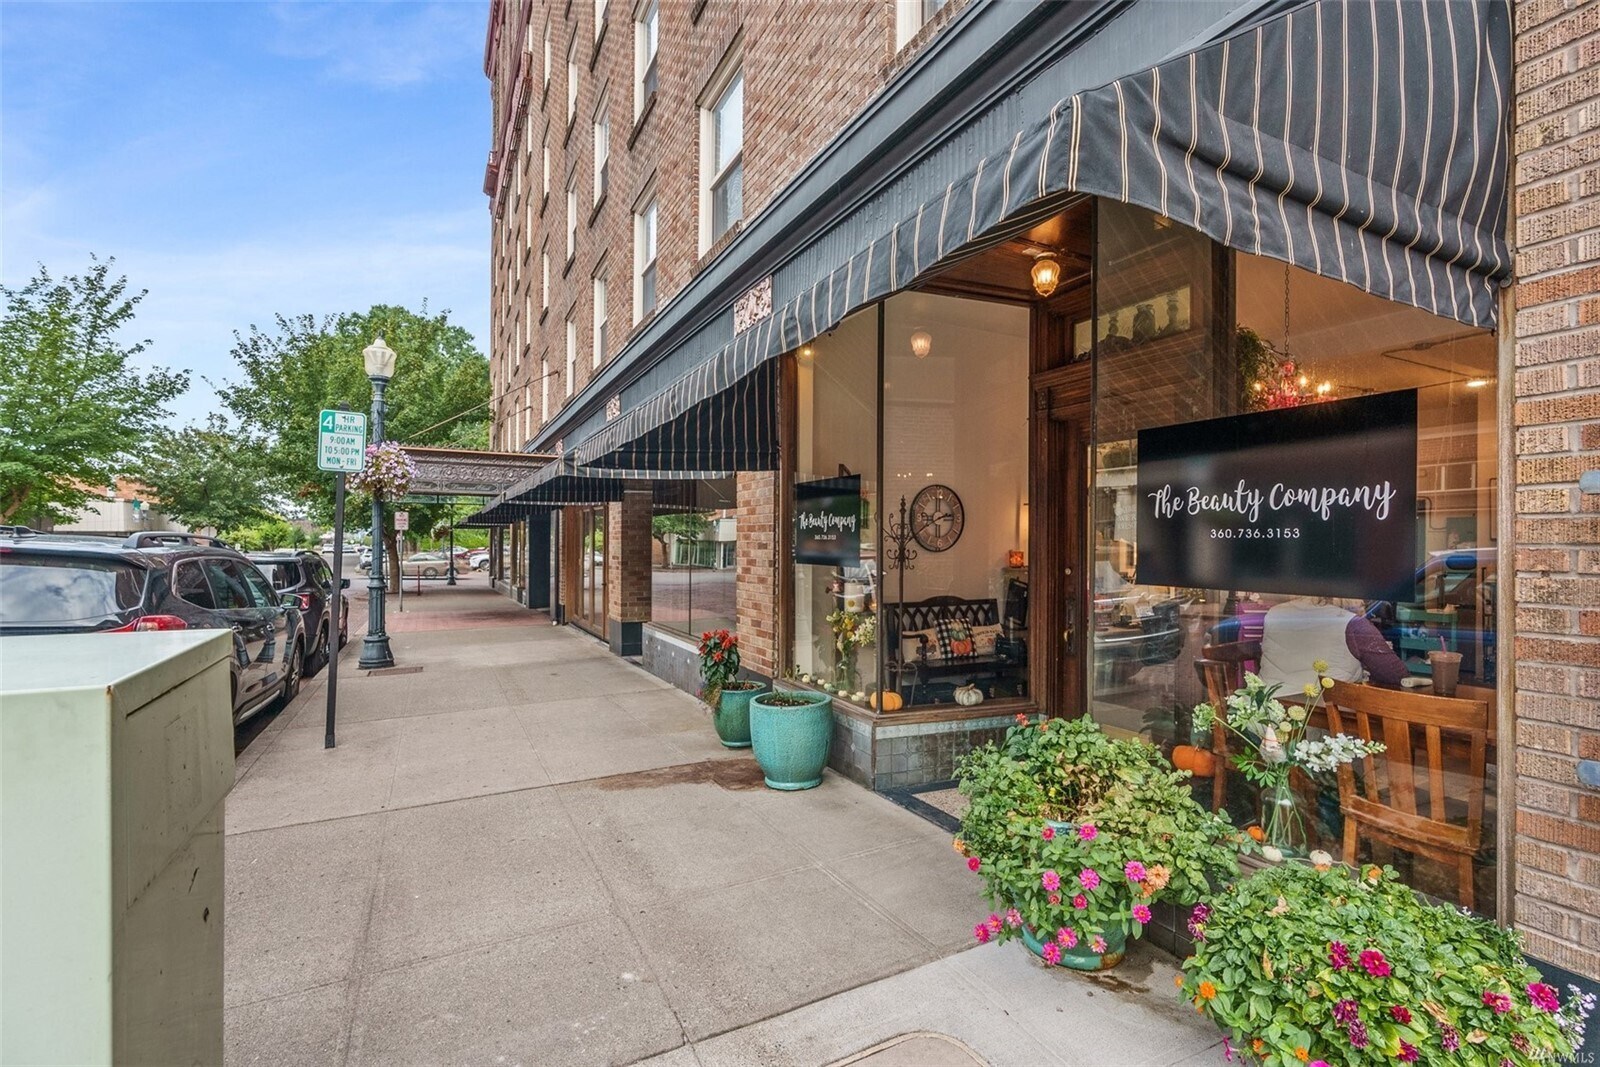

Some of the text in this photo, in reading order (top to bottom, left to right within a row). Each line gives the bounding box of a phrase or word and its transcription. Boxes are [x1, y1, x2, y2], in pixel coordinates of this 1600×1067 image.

[322, 415, 356, 430] 4 HR
[336, 424, 363, 433] PARKING
[330, 436, 346, 444] 9:00
[325, 446, 333, 454] TO
[334, 446, 350, 455] 5:00
[1148, 484, 1184, 519] The
[1186, 479, 1264, 523] Beauty
[1269, 480, 1397, 521] Company
[799, 510, 856, 533] The Beauty Company
[1210, 528, 1300, 539] 360.736.3153
